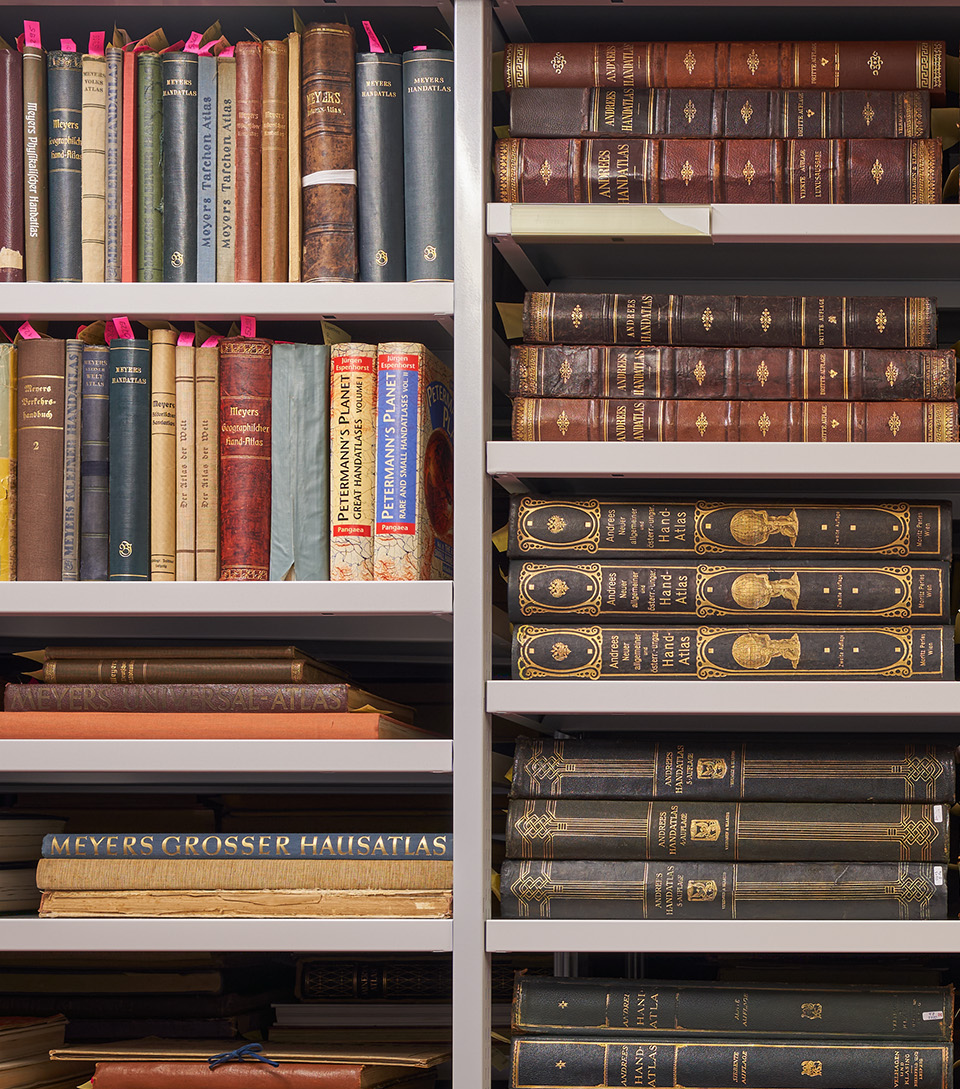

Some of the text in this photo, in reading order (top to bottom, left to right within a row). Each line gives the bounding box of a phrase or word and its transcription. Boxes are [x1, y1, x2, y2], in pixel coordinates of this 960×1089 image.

[408, 85, 451, 93] HANDATLAS
[27, 102, 37, 134] Meyers
[202, 97, 212, 127] Atlas
[221, 98, 232, 131] Atlas
[604, 91, 616, 127] ANDREES
[622, 89, 634, 131] HANDATLAS
[599, 150, 610, 198] ANDREES
[29, 193, 38, 238] Handatlas
[202, 198, 211, 248] Meyers
[222, 199, 232, 248] Meyers
[627, 300, 635, 337] ANDREES
[641, 296, 653, 343] HANDATLAS
[336, 364, 369, 372] Espenhorst
[381, 362, 415, 370] Espenhorst
[387, 355, 408, 363] Jürgen
[617, 354, 627, 391] ANDREES
[632, 350, 644, 396] HANDATLAS
[230, 407, 259, 417] Meyers
[400, 395, 408, 450] HANDATLASES
[33, 441, 39, 450] 2
[338, 375, 351, 521] PETERMANN'S PLANET
[354, 419, 362, 490] HANDATLASES
[382, 372, 396, 520] PETERMANN'S PLANET
[399, 452, 407, 479] SMALL
[353, 490, 361, 520] GREAT
[338, 526, 364, 534] Pangaea
[382, 524, 408, 532] Pangaea
[606, 509, 616, 543] Andrees
[674, 511, 687, 541] Atlas
[607, 573, 616, 606] Andrees
[676, 575, 688, 604] Atlas
[610, 635, 619, 669] Andrees
[622, 642, 630, 661] Neuer
[679, 636, 690, 666] Atlas
[50, 835, 447, 857] MEYERS GROSSER HAUSATLAS
[670, 806, 678, 855] HANDATLAS
[666, 866, 674, 915] HANDATLAS
[621, 1045, 629, 1087] ANDREES
[648, 1045, 658, 1087] ATLAS
